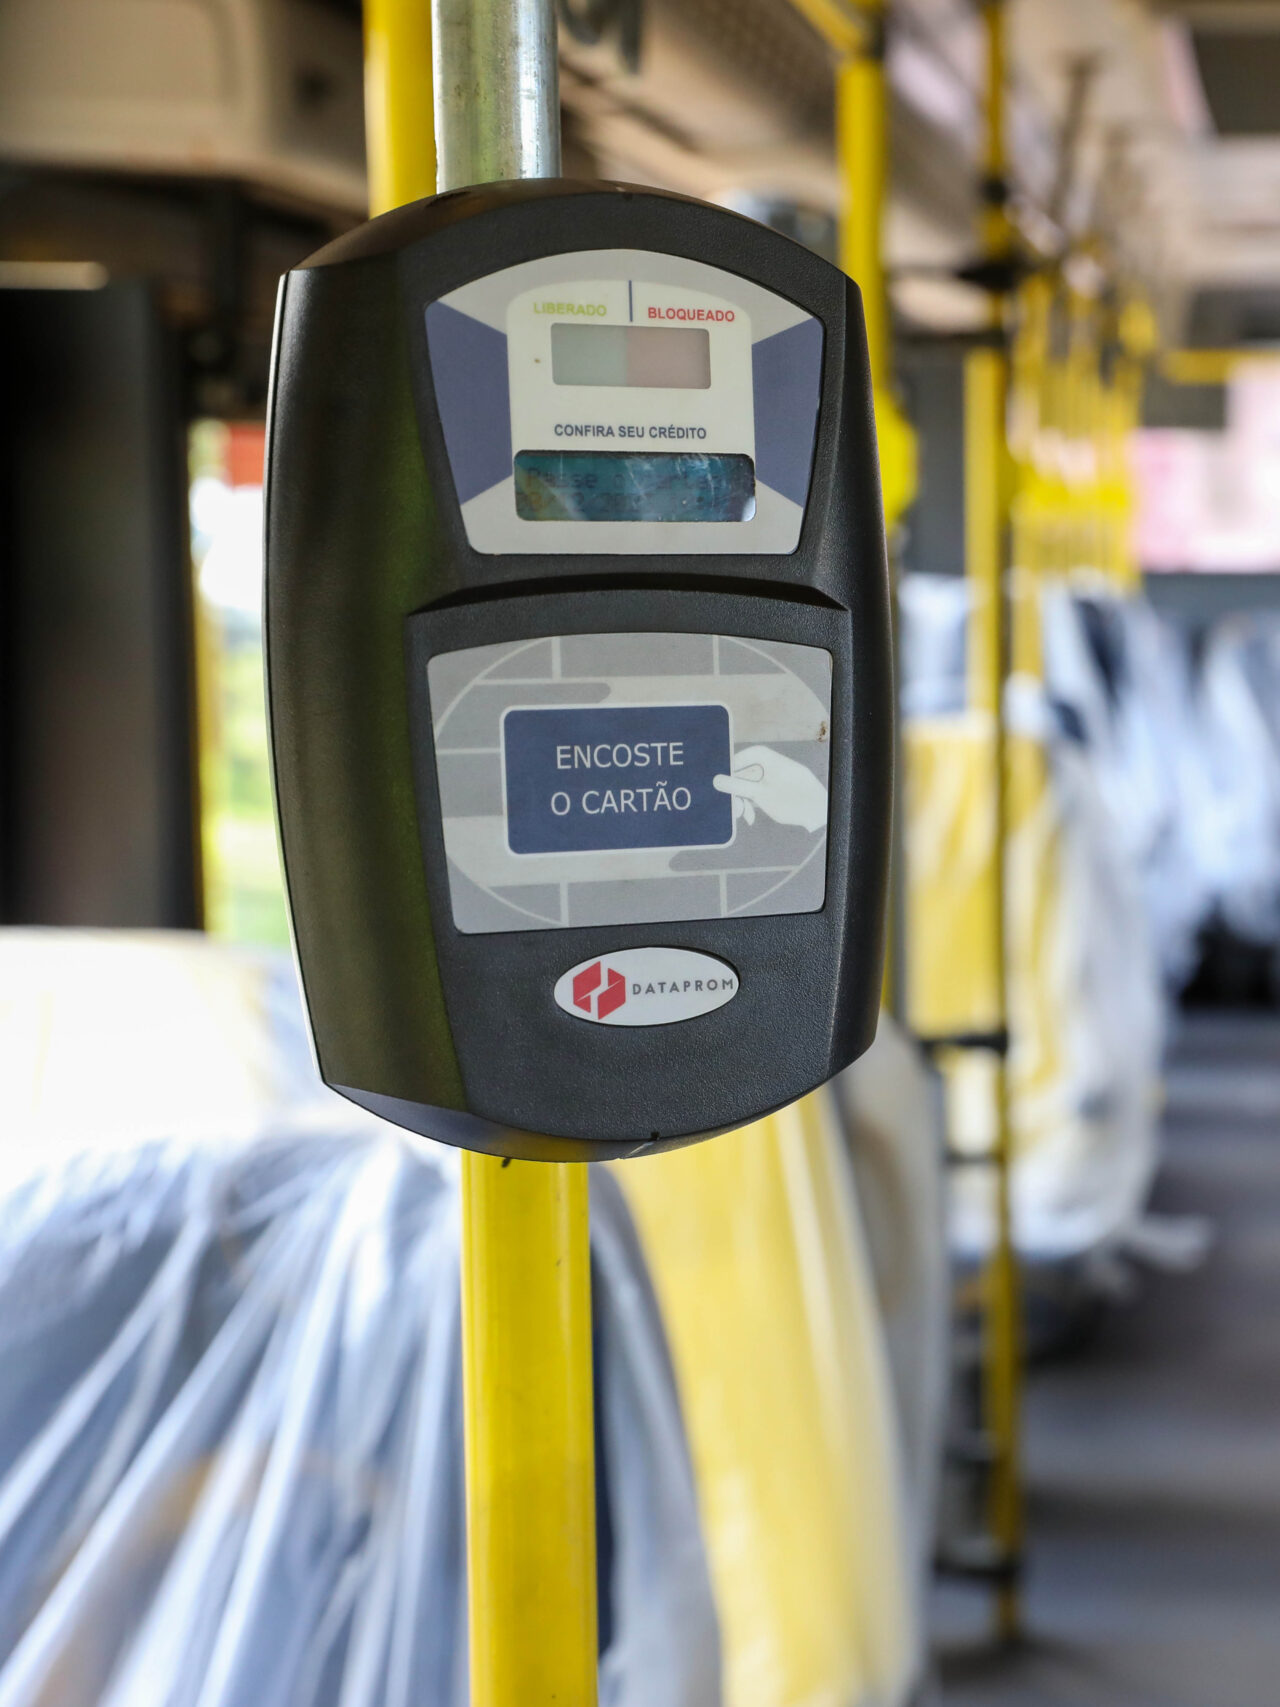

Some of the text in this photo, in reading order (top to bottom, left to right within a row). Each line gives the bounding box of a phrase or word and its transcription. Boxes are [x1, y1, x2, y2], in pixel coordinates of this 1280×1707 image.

[533, 302, 607, 317] LIBERADO
[647, 307, 735, 322] BLOQUEADO
[554, 424, 707, 440] CONFIRA SEU CRÉDITO
[556, 742, 684, 770] ENCOSTE
[550, 781, 691, 816] O CARTÃO
[632, 978, 734, 995] DATAPROM
